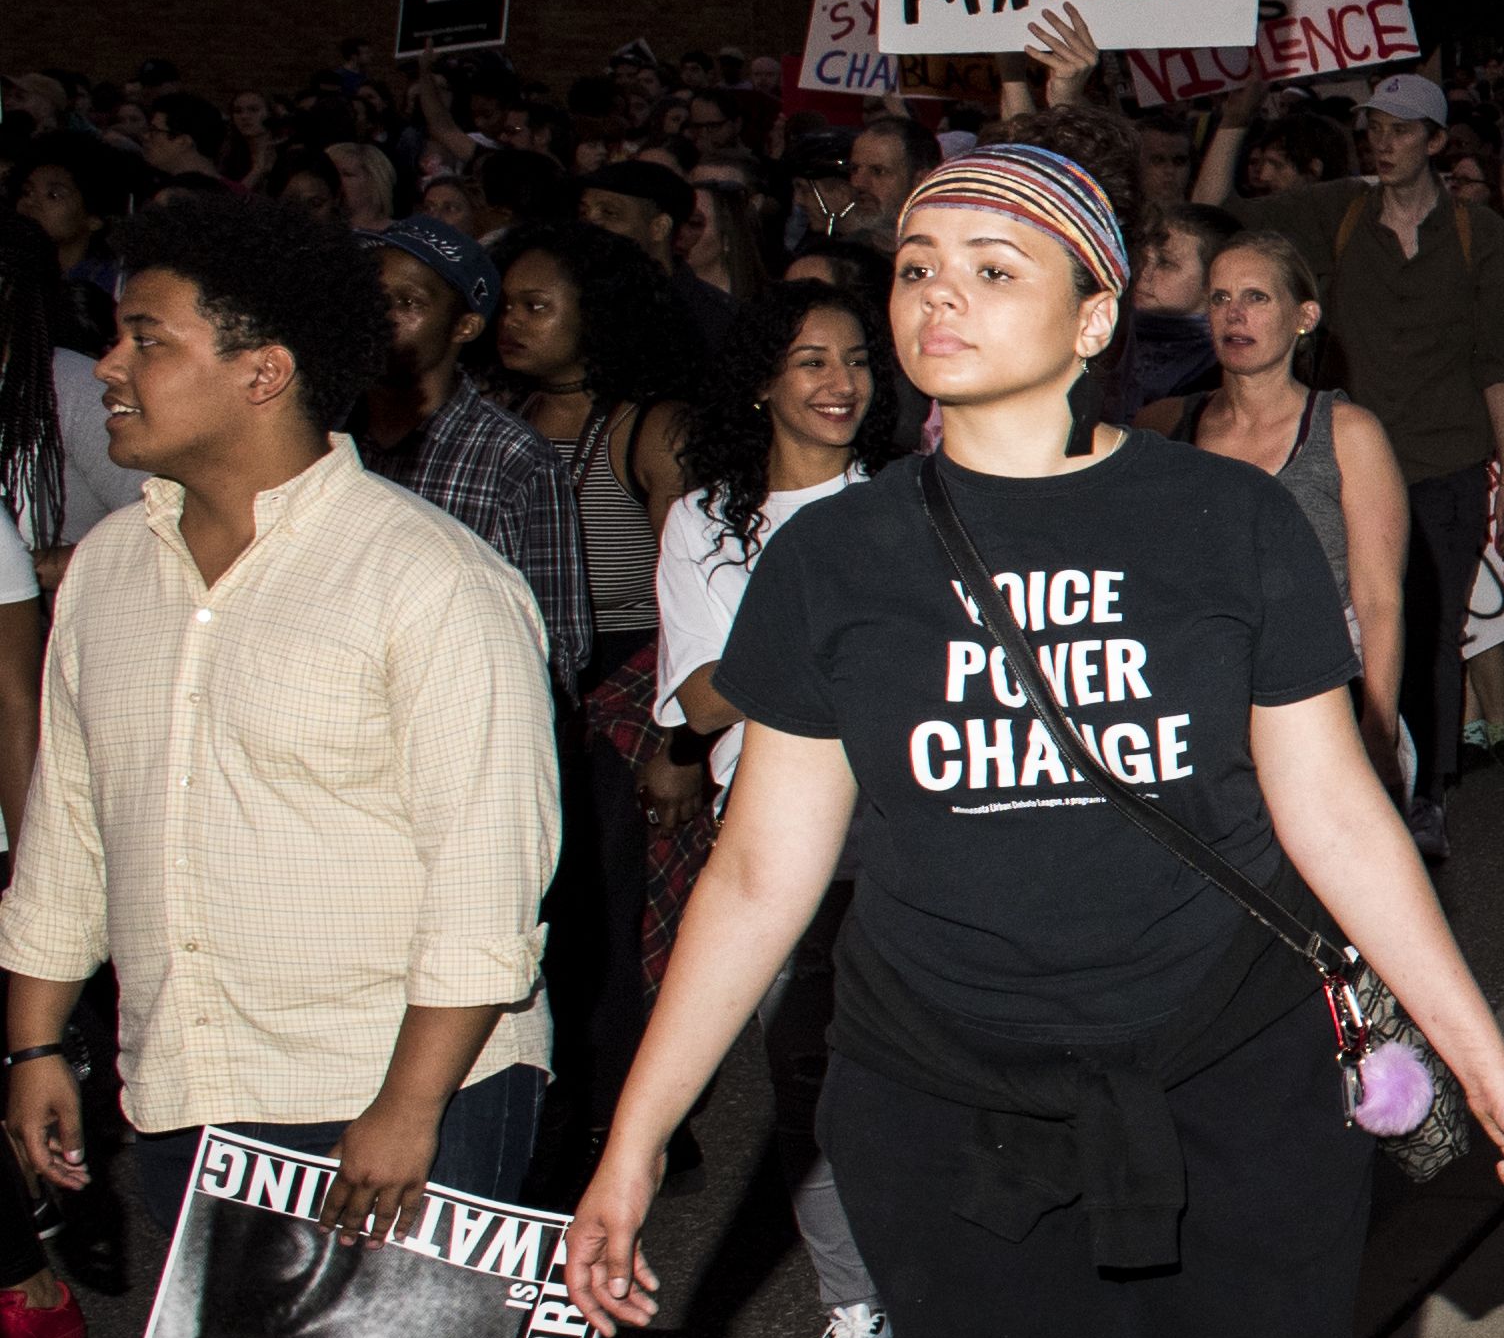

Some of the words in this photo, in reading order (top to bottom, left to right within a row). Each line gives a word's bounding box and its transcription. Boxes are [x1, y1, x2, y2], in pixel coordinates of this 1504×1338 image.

[580, 415, 607, 460] DIGITAL
[201, 1137, 546, 1281] WATING
[504, 1281, 540, 1310] IS
